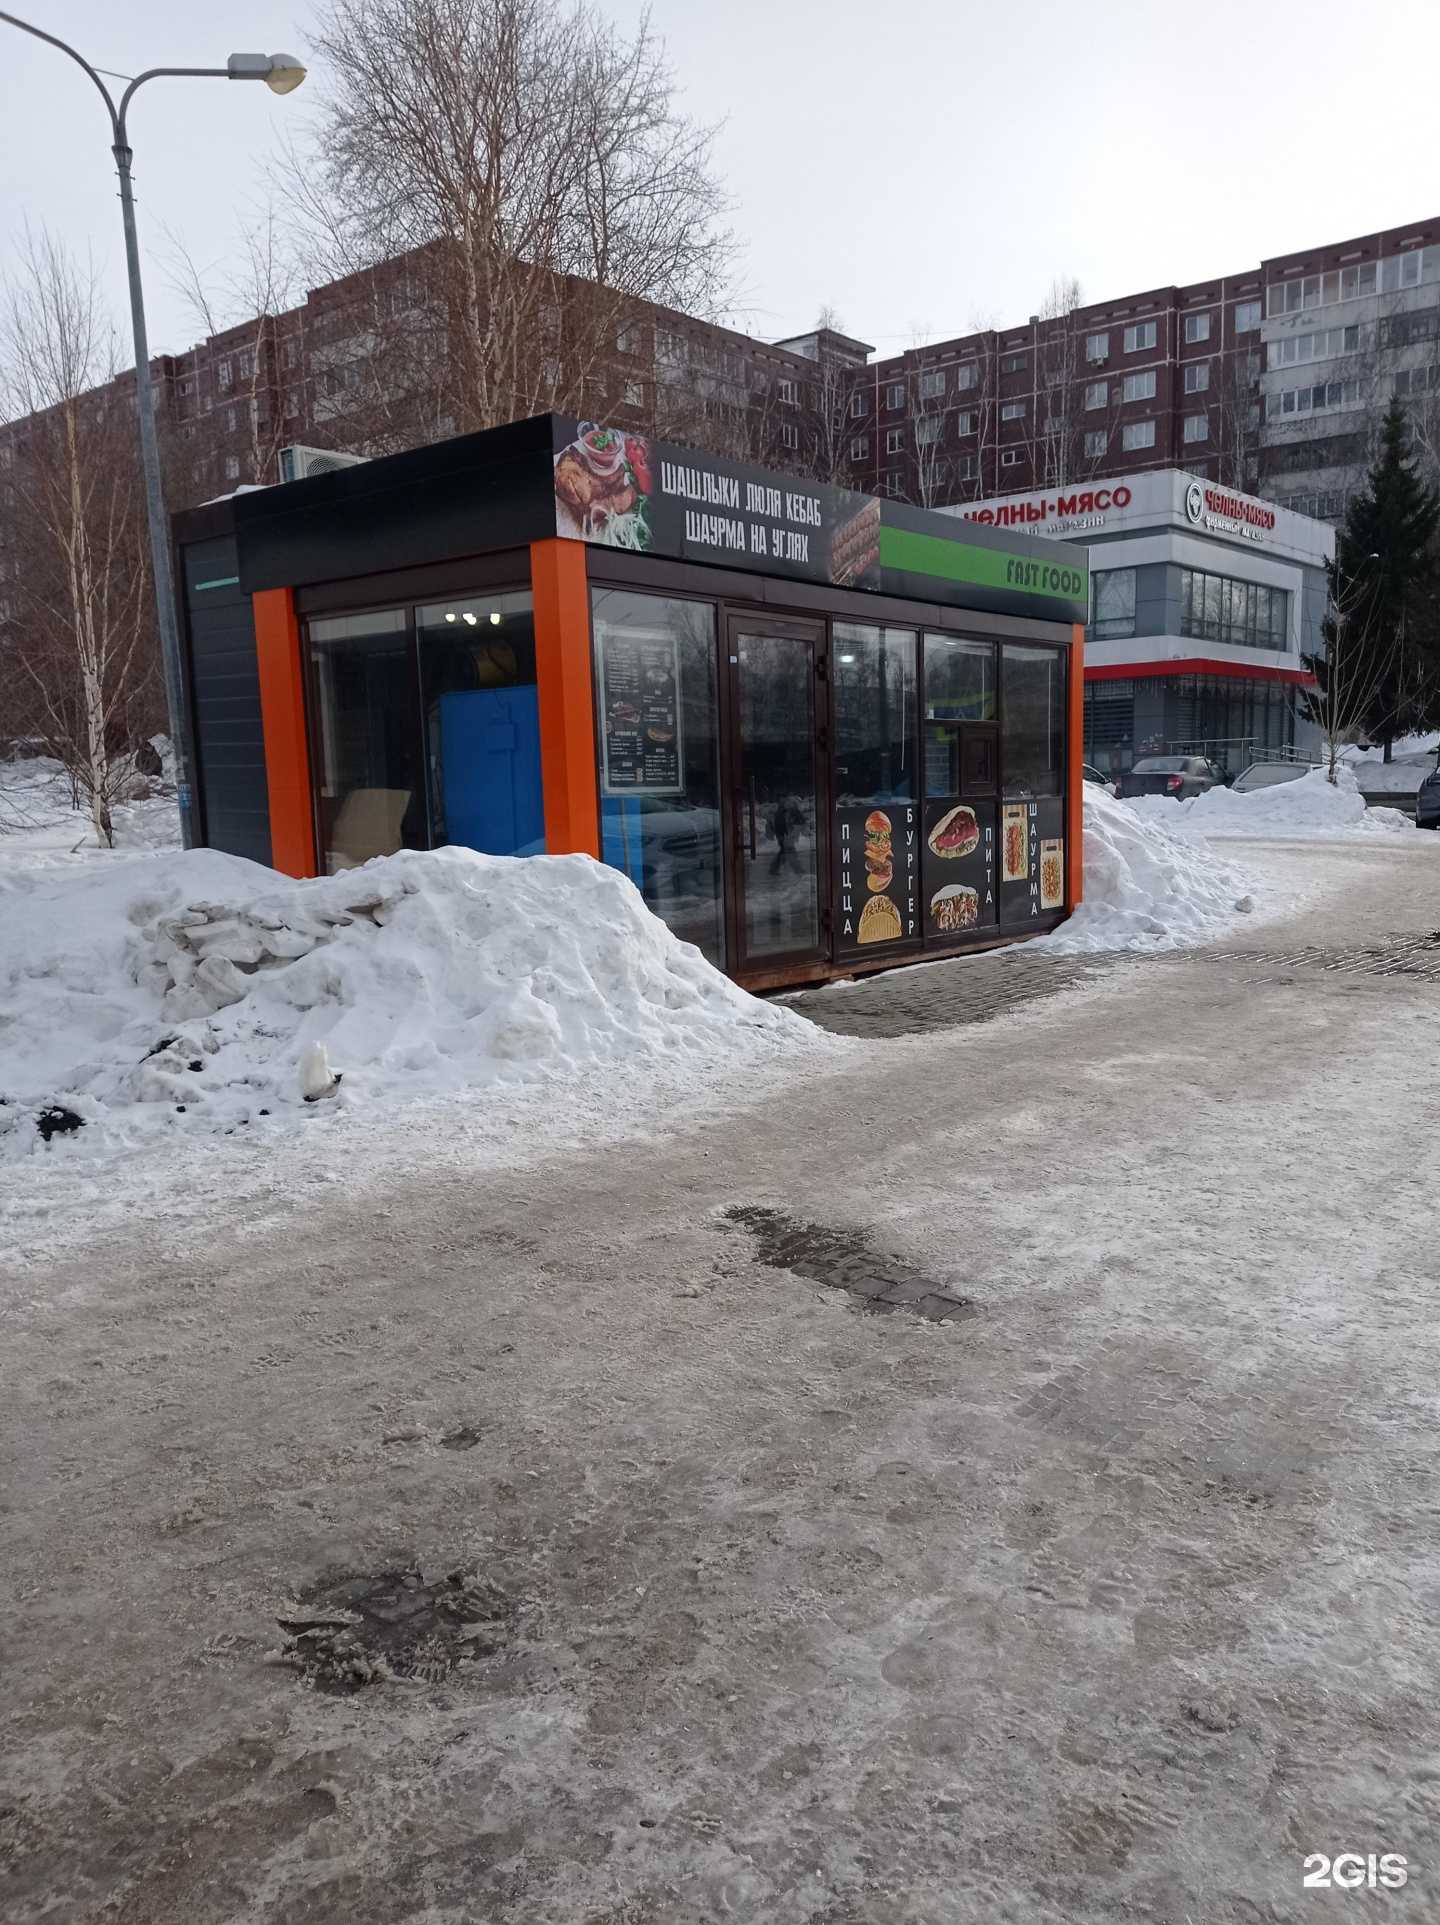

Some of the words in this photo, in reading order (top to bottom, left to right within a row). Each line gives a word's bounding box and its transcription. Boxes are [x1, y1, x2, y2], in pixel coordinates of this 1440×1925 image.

[661, 461, 740, 509] ШАШЛЫКИ
[745, 482, 781, 518] ЛЮЛЯ
[786, 492, 822, 527] КЕБАБ
[685, 510, 746, 551] ШАУРМА
[751, 523, 768, 555] НА
[772, 528, 809, 563] УГЛЯХ
[1006, 559, 1040, 588] FAST
[1042, 566, 1082, 594] FOOD
[841, 823, 853, 935] ПИЦЦА
[906, 808, 914, 935] БУРГЕР
[985, 827, 993, 904] ПИТА
[1029, 803, 1038, 915] ШАУРМА
